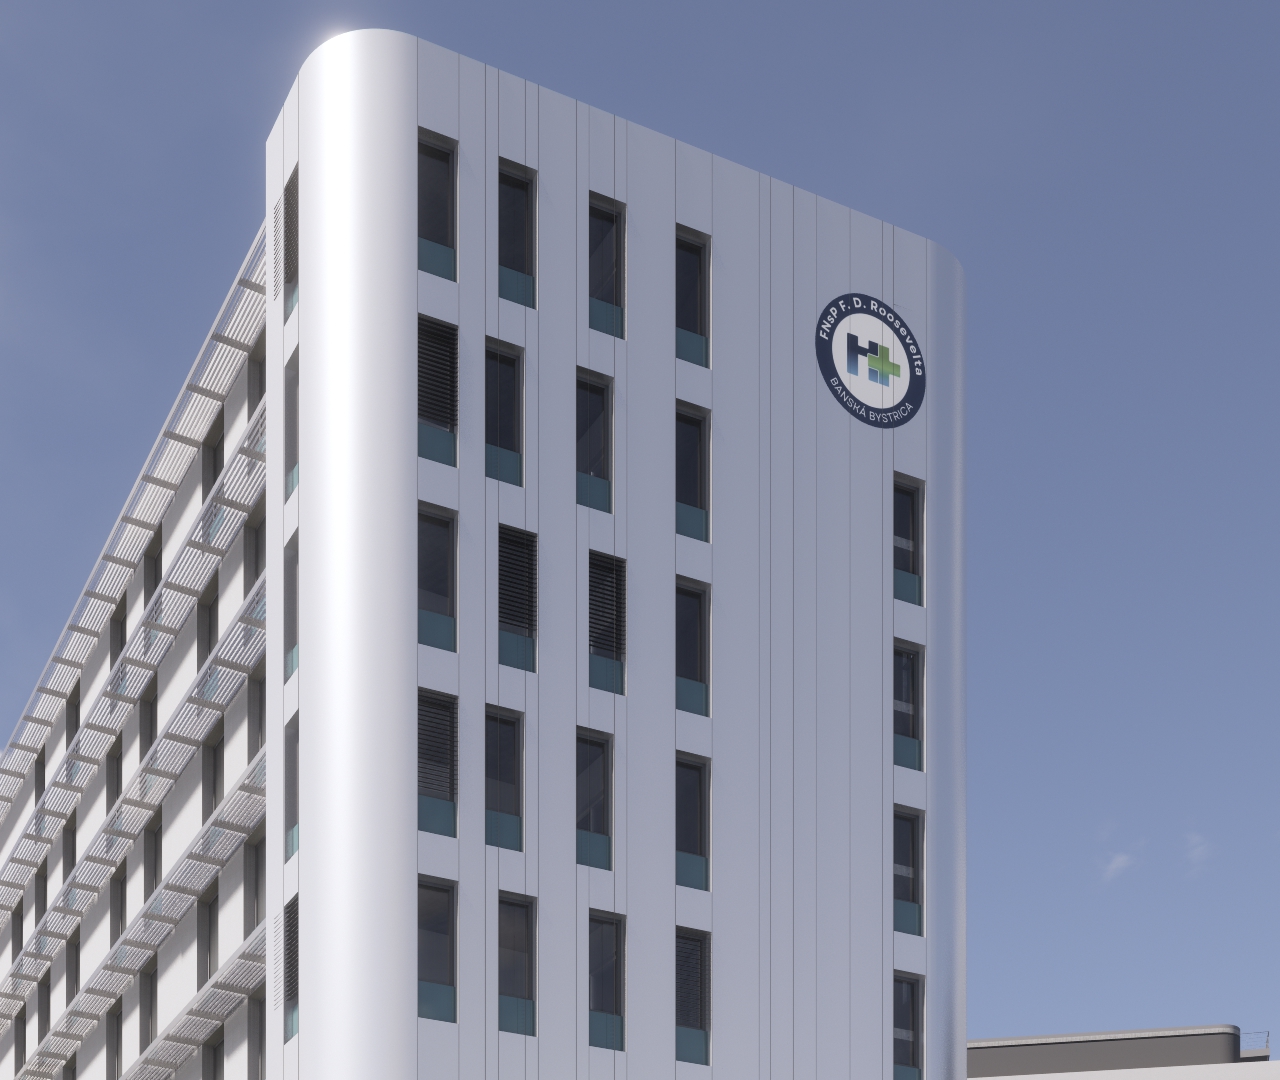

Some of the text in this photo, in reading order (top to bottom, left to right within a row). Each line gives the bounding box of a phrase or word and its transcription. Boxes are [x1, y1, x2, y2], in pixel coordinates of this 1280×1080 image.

[819, 297, 923, 376] FNsP F. D. Roosevelta
[830, 377, 914, 423] BANSKÁ BYSTRICA
